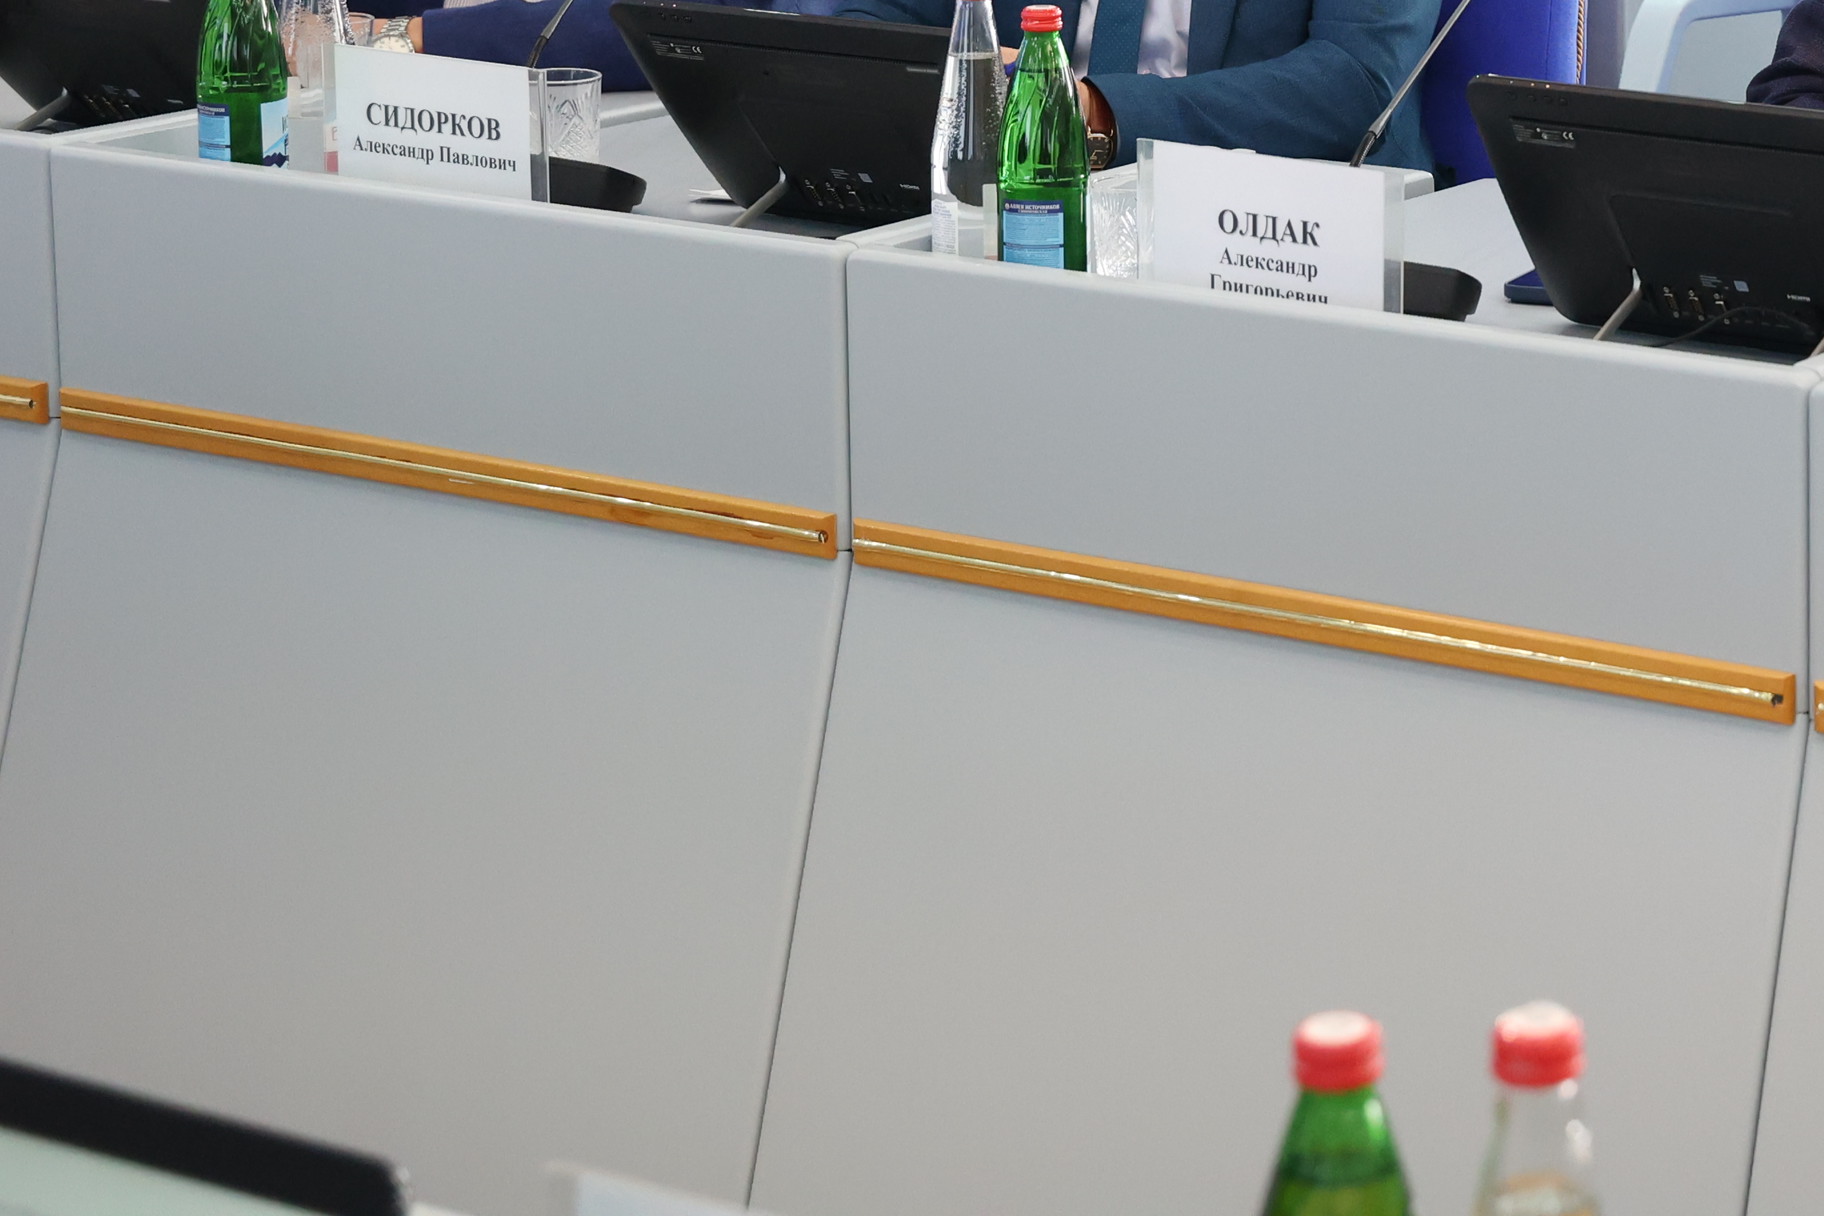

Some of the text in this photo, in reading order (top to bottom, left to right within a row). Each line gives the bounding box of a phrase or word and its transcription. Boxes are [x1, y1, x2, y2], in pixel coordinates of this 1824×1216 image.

[366, 101, 501, 141] СИДОРКОВ
[353, 134, 517, 172] Александр Павлович
[1218, 208, 1321, 247] ОЛДАК
[1219, 246, 1318, 282] Александр
